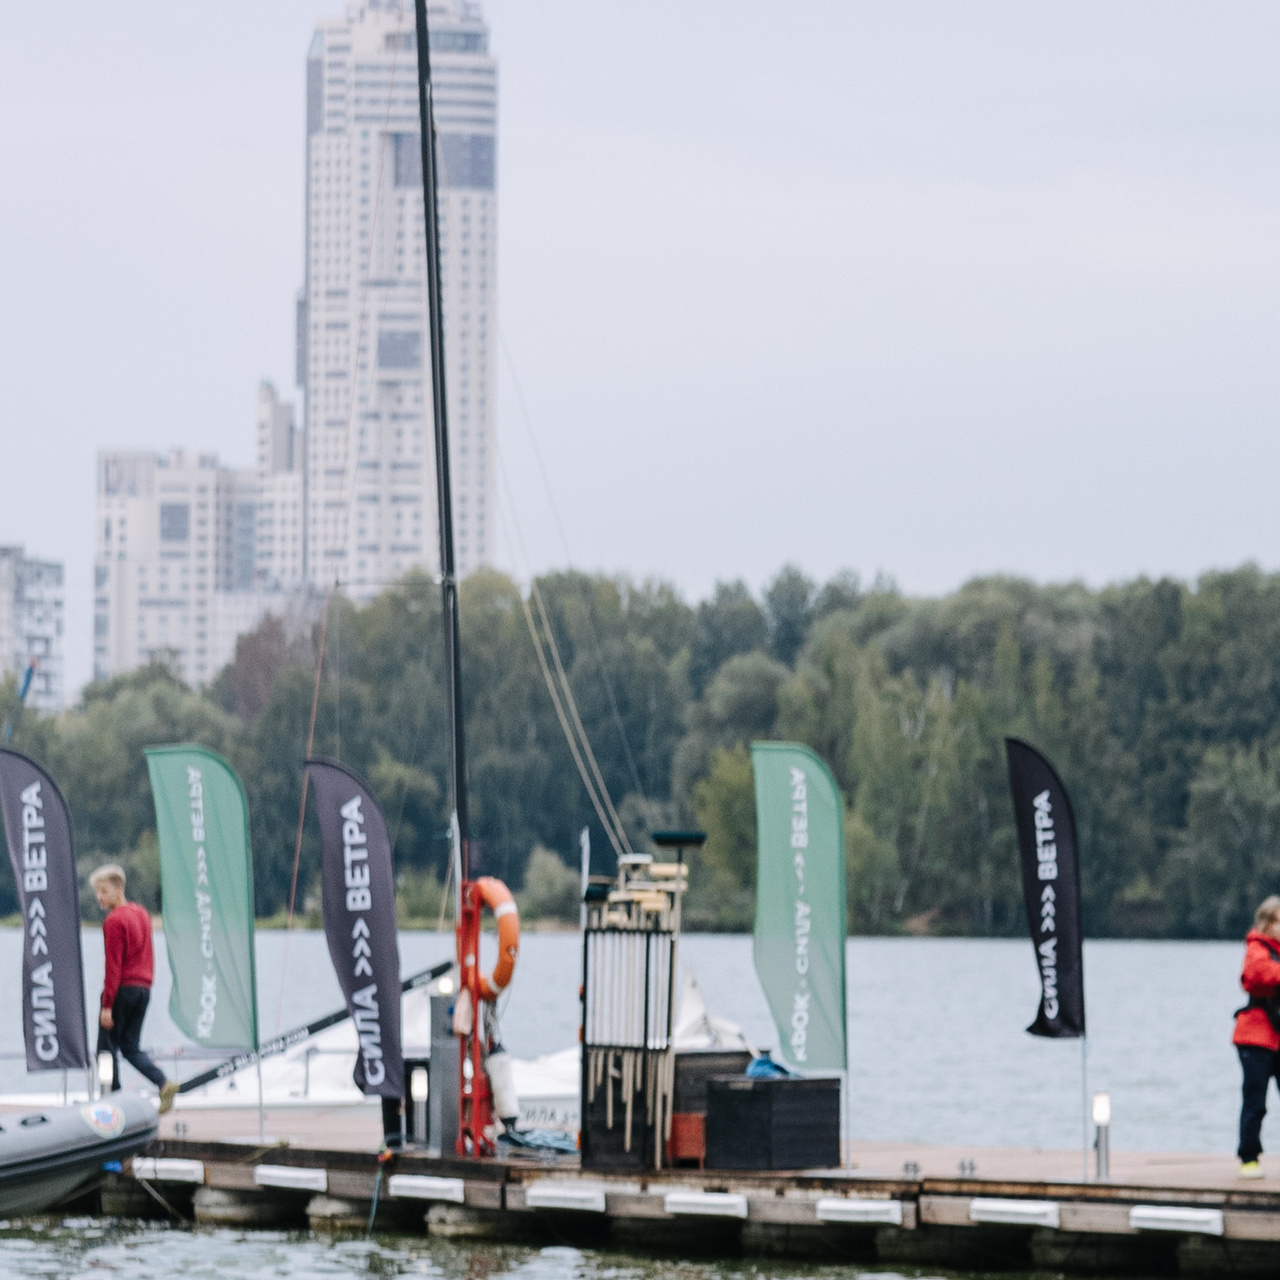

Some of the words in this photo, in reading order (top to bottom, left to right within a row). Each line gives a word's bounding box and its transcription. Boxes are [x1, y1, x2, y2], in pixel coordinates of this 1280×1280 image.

[22, 780, 47, 893] ВЕТРА
[341, 795, 371, 911] ВЕТРА
[1033, 789, 1058, 880] ВЕТРА
[31, 961, 59, 1061] СИЛА
[352, 983, 385, 1086] СИЛА
